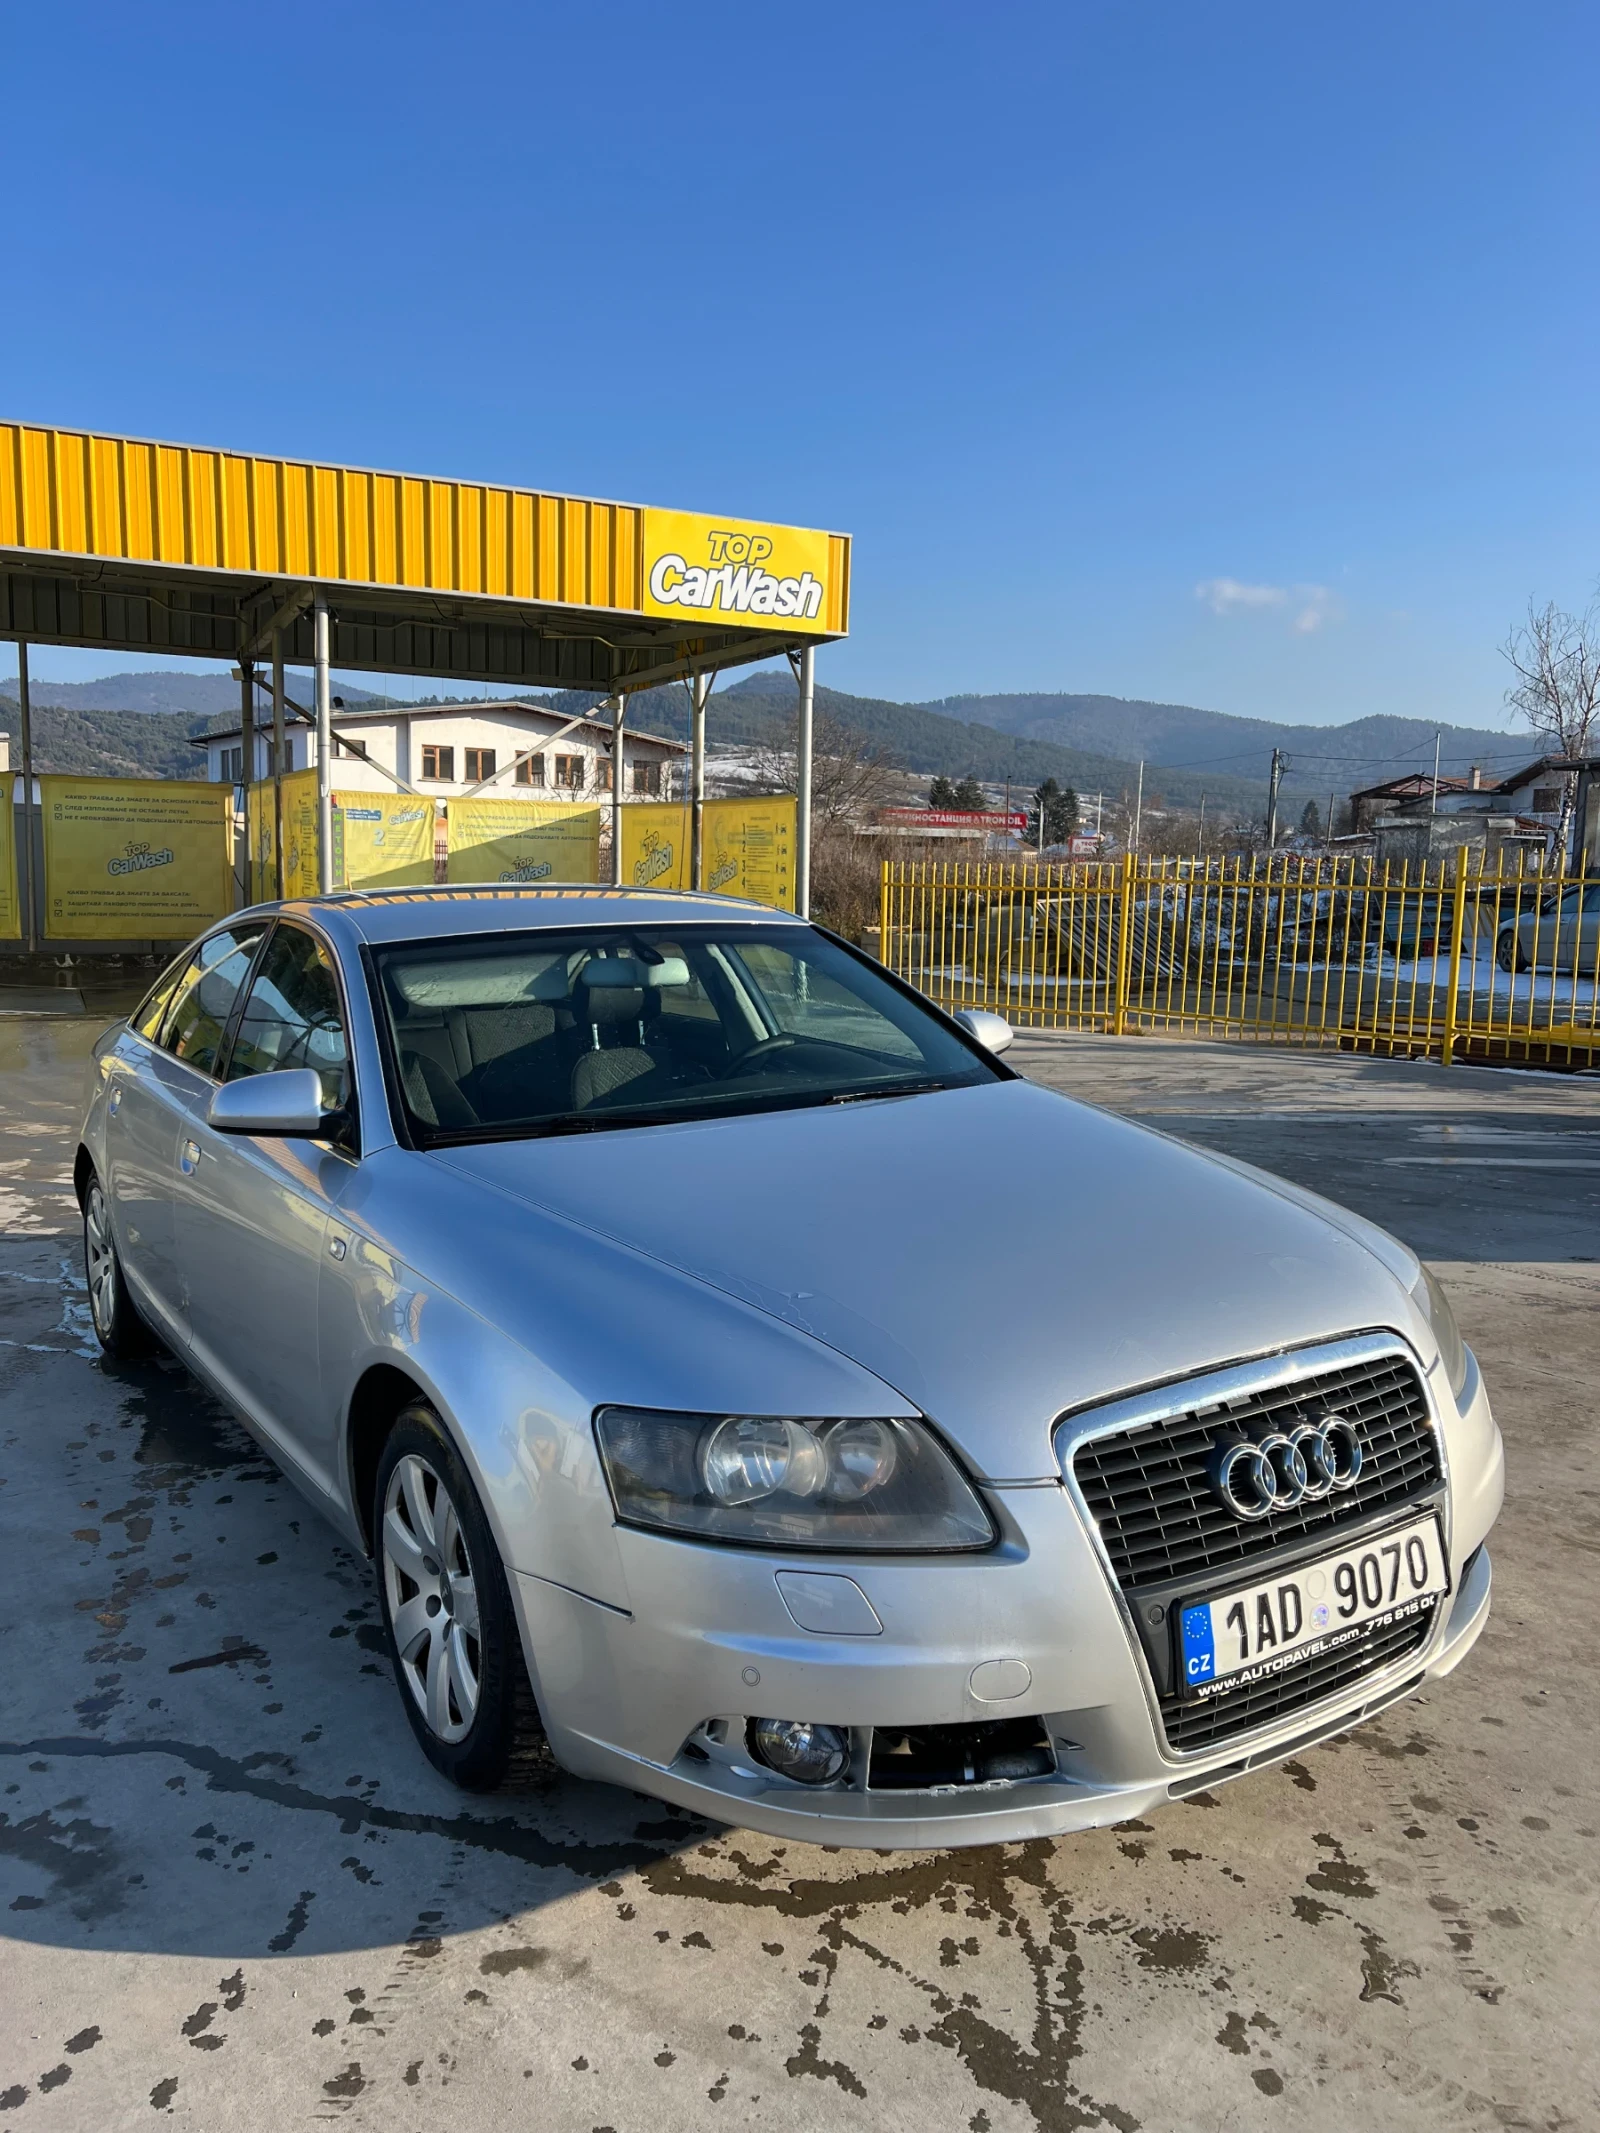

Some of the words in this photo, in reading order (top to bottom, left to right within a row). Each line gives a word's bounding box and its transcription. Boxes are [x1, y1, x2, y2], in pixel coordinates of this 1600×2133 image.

[708, 531, 773, 565] TOP
[650, 553, 823, 618] CarWash
[83, 805, 127, 813] ИЗПЛАКВАНЕ
[980, 815, 1006, 825] TRON
[1008, 816, 1023, 826] OIL
[373, 828, 386, 847] 2
[125, 842, 150, 857] TOP
[108, 848, 174, 876] CarWash
[499, 862, 551, 882] CarWash
[513, 856, 534, 870] TOP
[1227, 1583, 1303, 1659] 1AD
[1334, 1535, 1429, 1618] 9070
[1197, 1628, 1359, 1697] www.AUTOPAVEL.com
[1365, 1612, 1393, 1631] 776
[1394, 1602, 1419, 1621] 815
[1188, 1653, 1211, 1675] CZ
